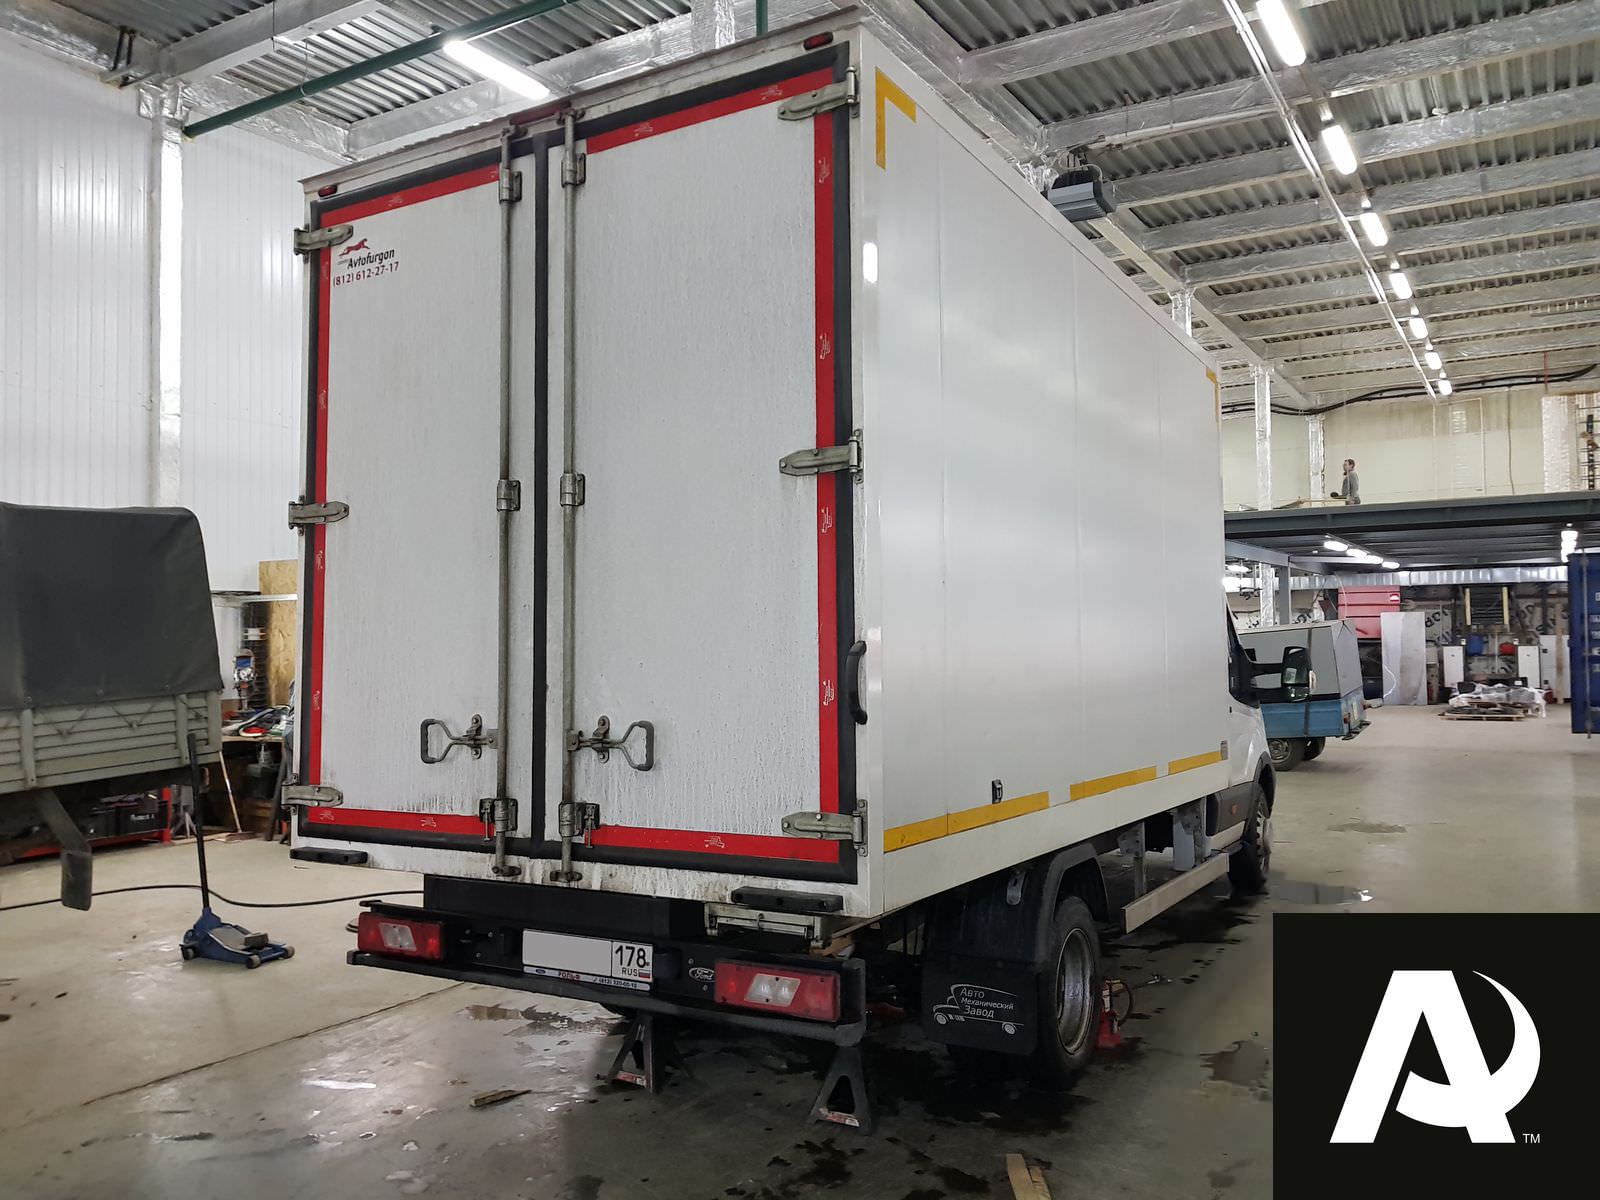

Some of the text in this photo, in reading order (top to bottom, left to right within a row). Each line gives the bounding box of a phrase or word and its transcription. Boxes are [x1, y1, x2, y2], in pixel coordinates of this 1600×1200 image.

[347, 250, 395, 269] Avtofurgon
[333, 272, 354, 288] (812)
[355, 261, 399, 281] 612-27-17
[615, 944, 646, 968] 178
[621, 967, 638, 977] RUS
